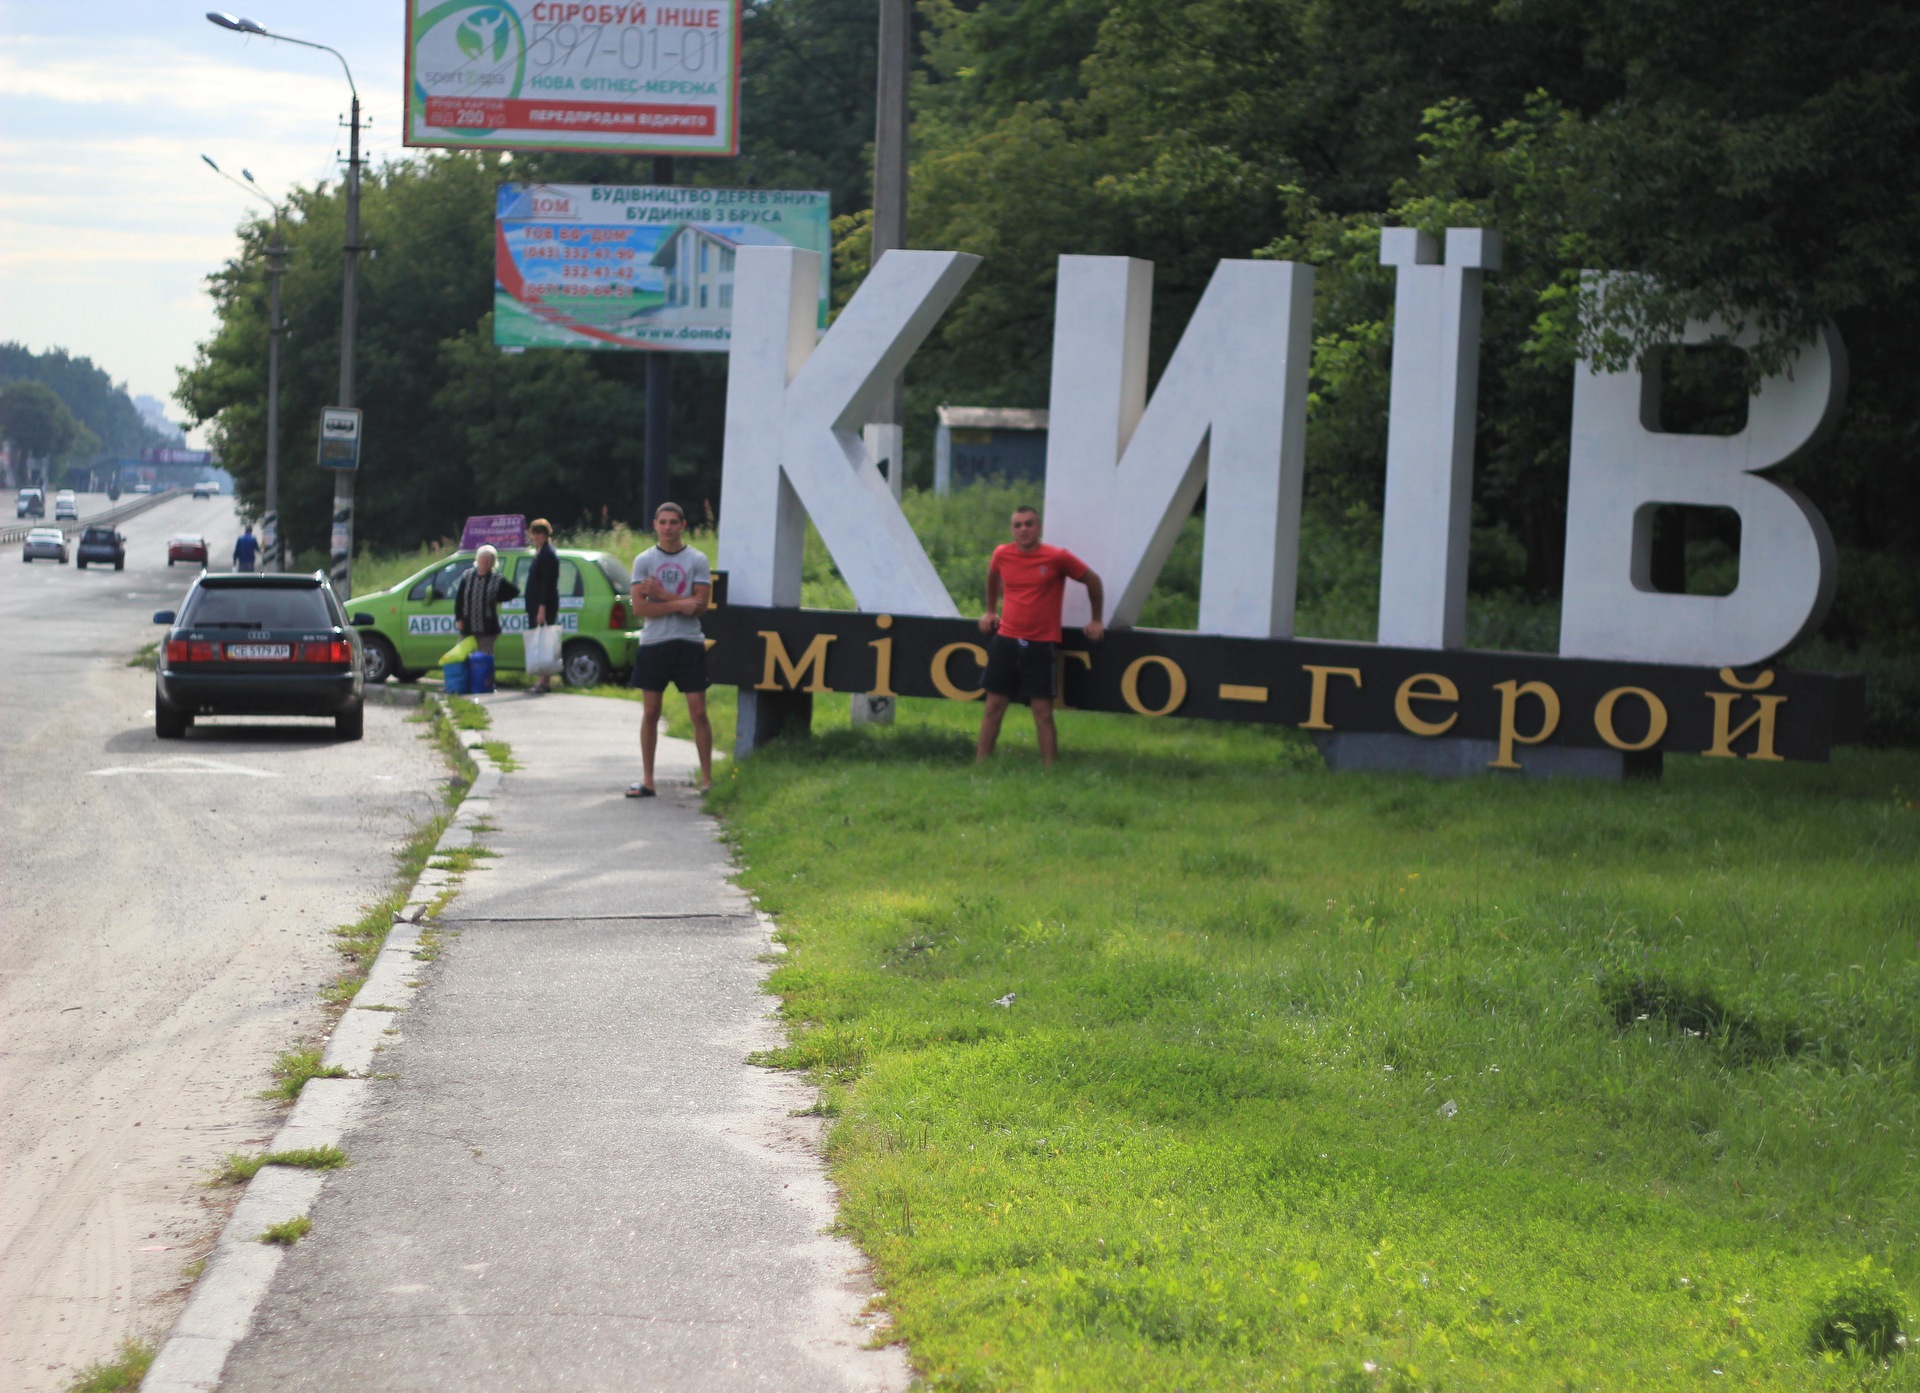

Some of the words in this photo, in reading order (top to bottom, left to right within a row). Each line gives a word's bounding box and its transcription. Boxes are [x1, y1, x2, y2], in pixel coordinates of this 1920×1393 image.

[532, 2, 647, 25] СПРОБУЙ
[656, 8, 720, 27] ІНШЕ
[532, 22, 720, 73] 597-01-01
[531, 76, 575, 90] НОВА
[580, 77, 718, 95] ФІТНЕС-МЕРЕЖА
[529, 108, 636, 125] ПЕРЕДПРОДАЖ
[591, 187, 713, 204] БУДІВНИЦТВО
[626, 206, 712, 222] БУДИНКІВ
[729, 209, 782, 223] БРУСА
[523, 226, 553, 240] ТОВ
[718, 226, 1848, 668] КИЇВ
